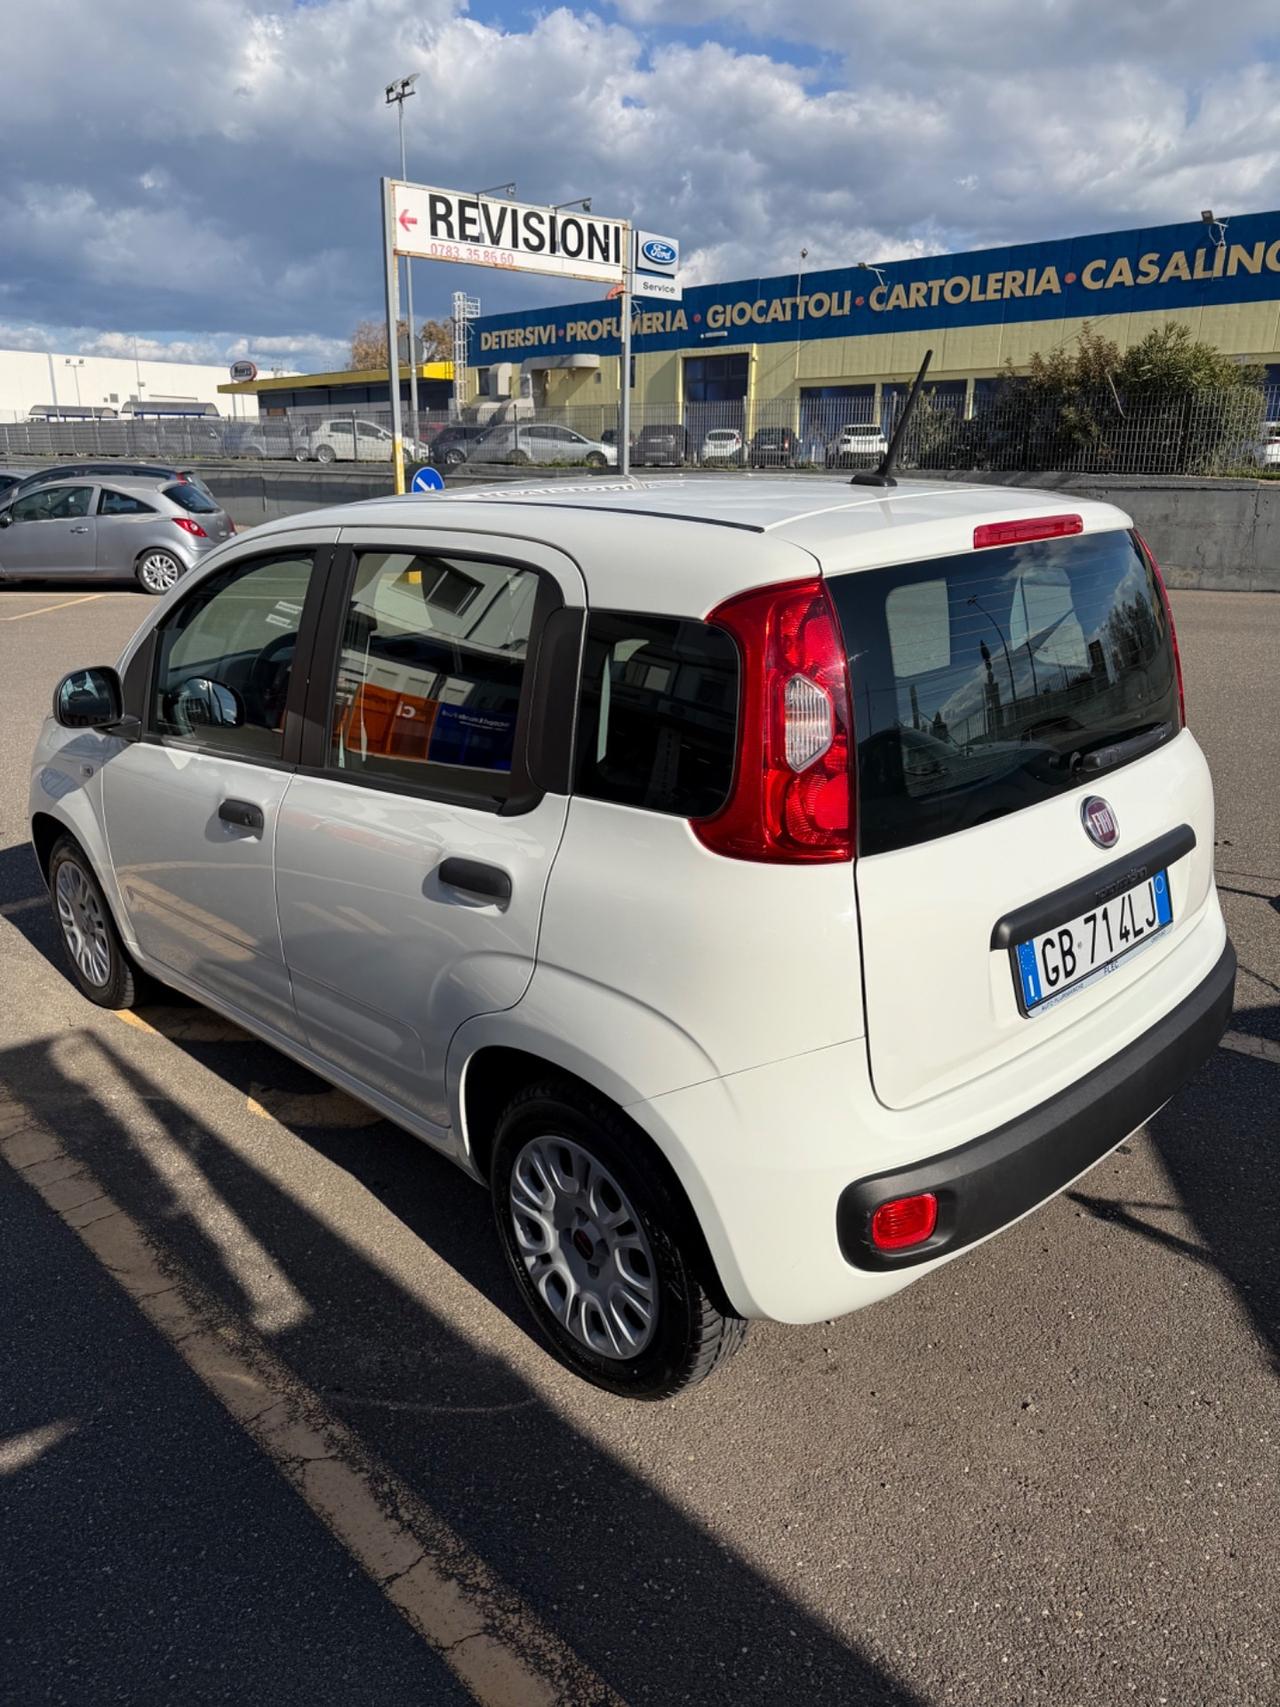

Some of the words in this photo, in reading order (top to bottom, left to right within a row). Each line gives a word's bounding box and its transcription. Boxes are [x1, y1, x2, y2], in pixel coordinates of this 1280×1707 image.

[429, 194, 621, 263] REVISIONI
[430, 243, 460, 257] 0783
[466, 248, 480, 260] 35
[483, 250, 498, 263] 86
[500, 252, 514, 265] 60
[650, 244, 673, 260] Ford
[642, 281, 676, 294] Service
[480, 324, 557, 351] DETERSIVI
[706, 290, 852, 329] GIOCATTOLI
[869, 265, 1062, 311] CARTOLERIA
